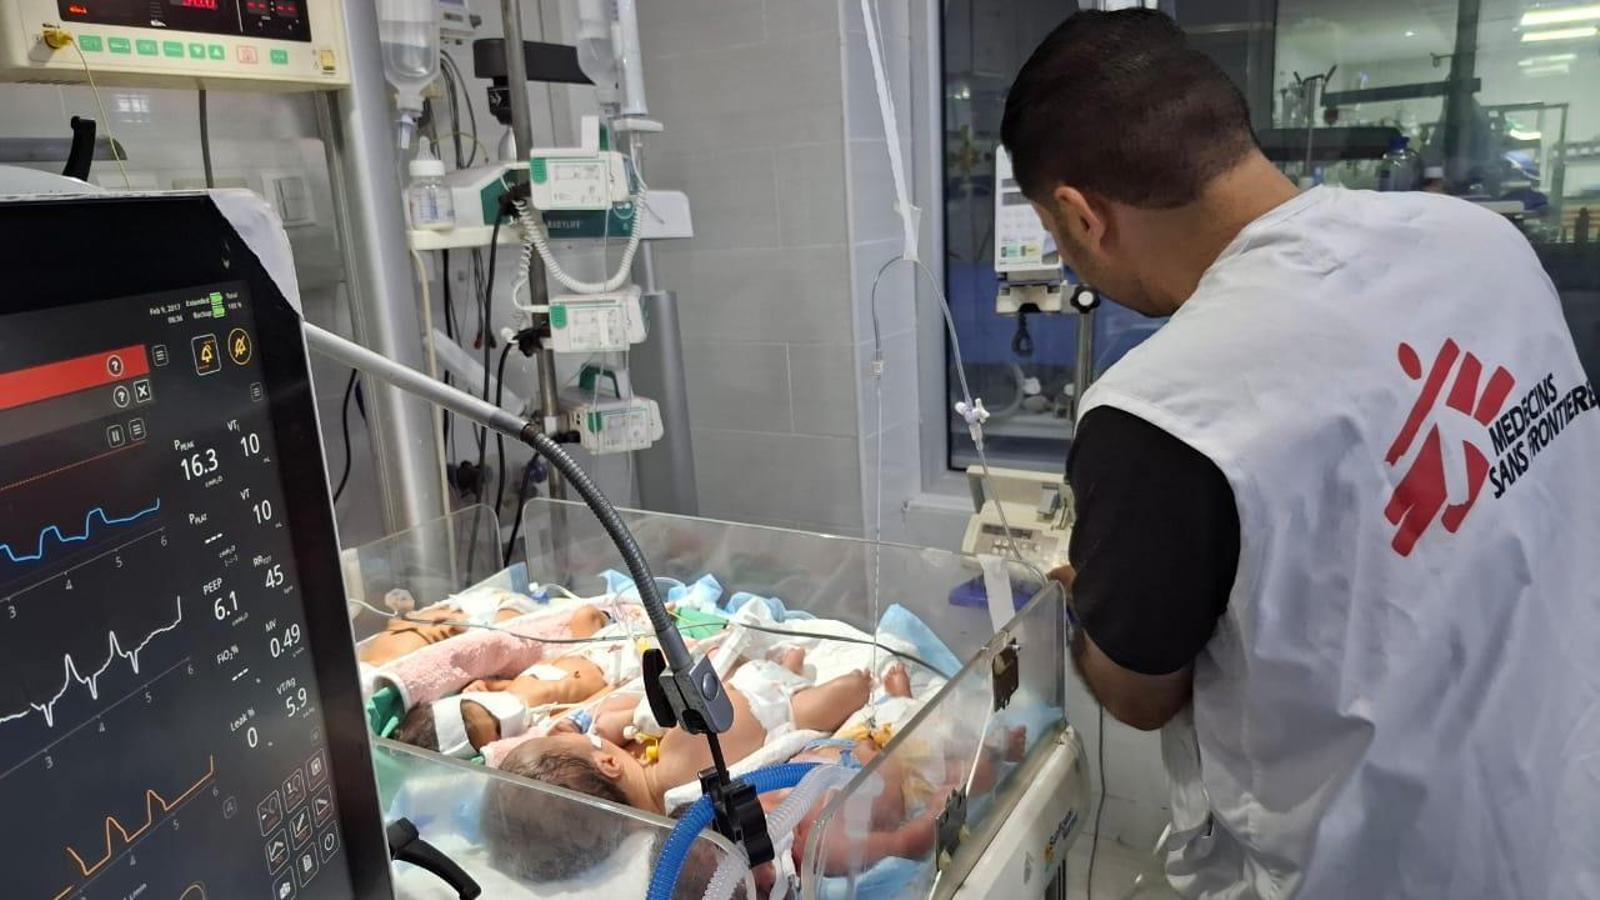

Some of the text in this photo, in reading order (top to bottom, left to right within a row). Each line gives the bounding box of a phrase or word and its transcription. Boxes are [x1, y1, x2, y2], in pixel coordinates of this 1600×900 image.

[1488, 372, 1558, 456] MEDECINS
[240, 432, 260, 457] 10
[180, 448, 219, 481] 16.3
[1488, 441, 1530, 499] SANS
[253, 499, 272, 525] 10
[8, 535, 168, 619] 3 4 5 6
[203, 577, 222, 596] PEEP
[265, 563, 284, 588] 45
[214, 590, 238, 620] 6.1
[270, 623, 301, 658] 0.49
[45, 663, 194, 769] 3 4 5 6
[286, 687, 307, 718] 5.9
[230, 712, 248, 733] Leak
[247, 726, 258, 748] 0
[129, 786, 219, 866] 4 5 6
